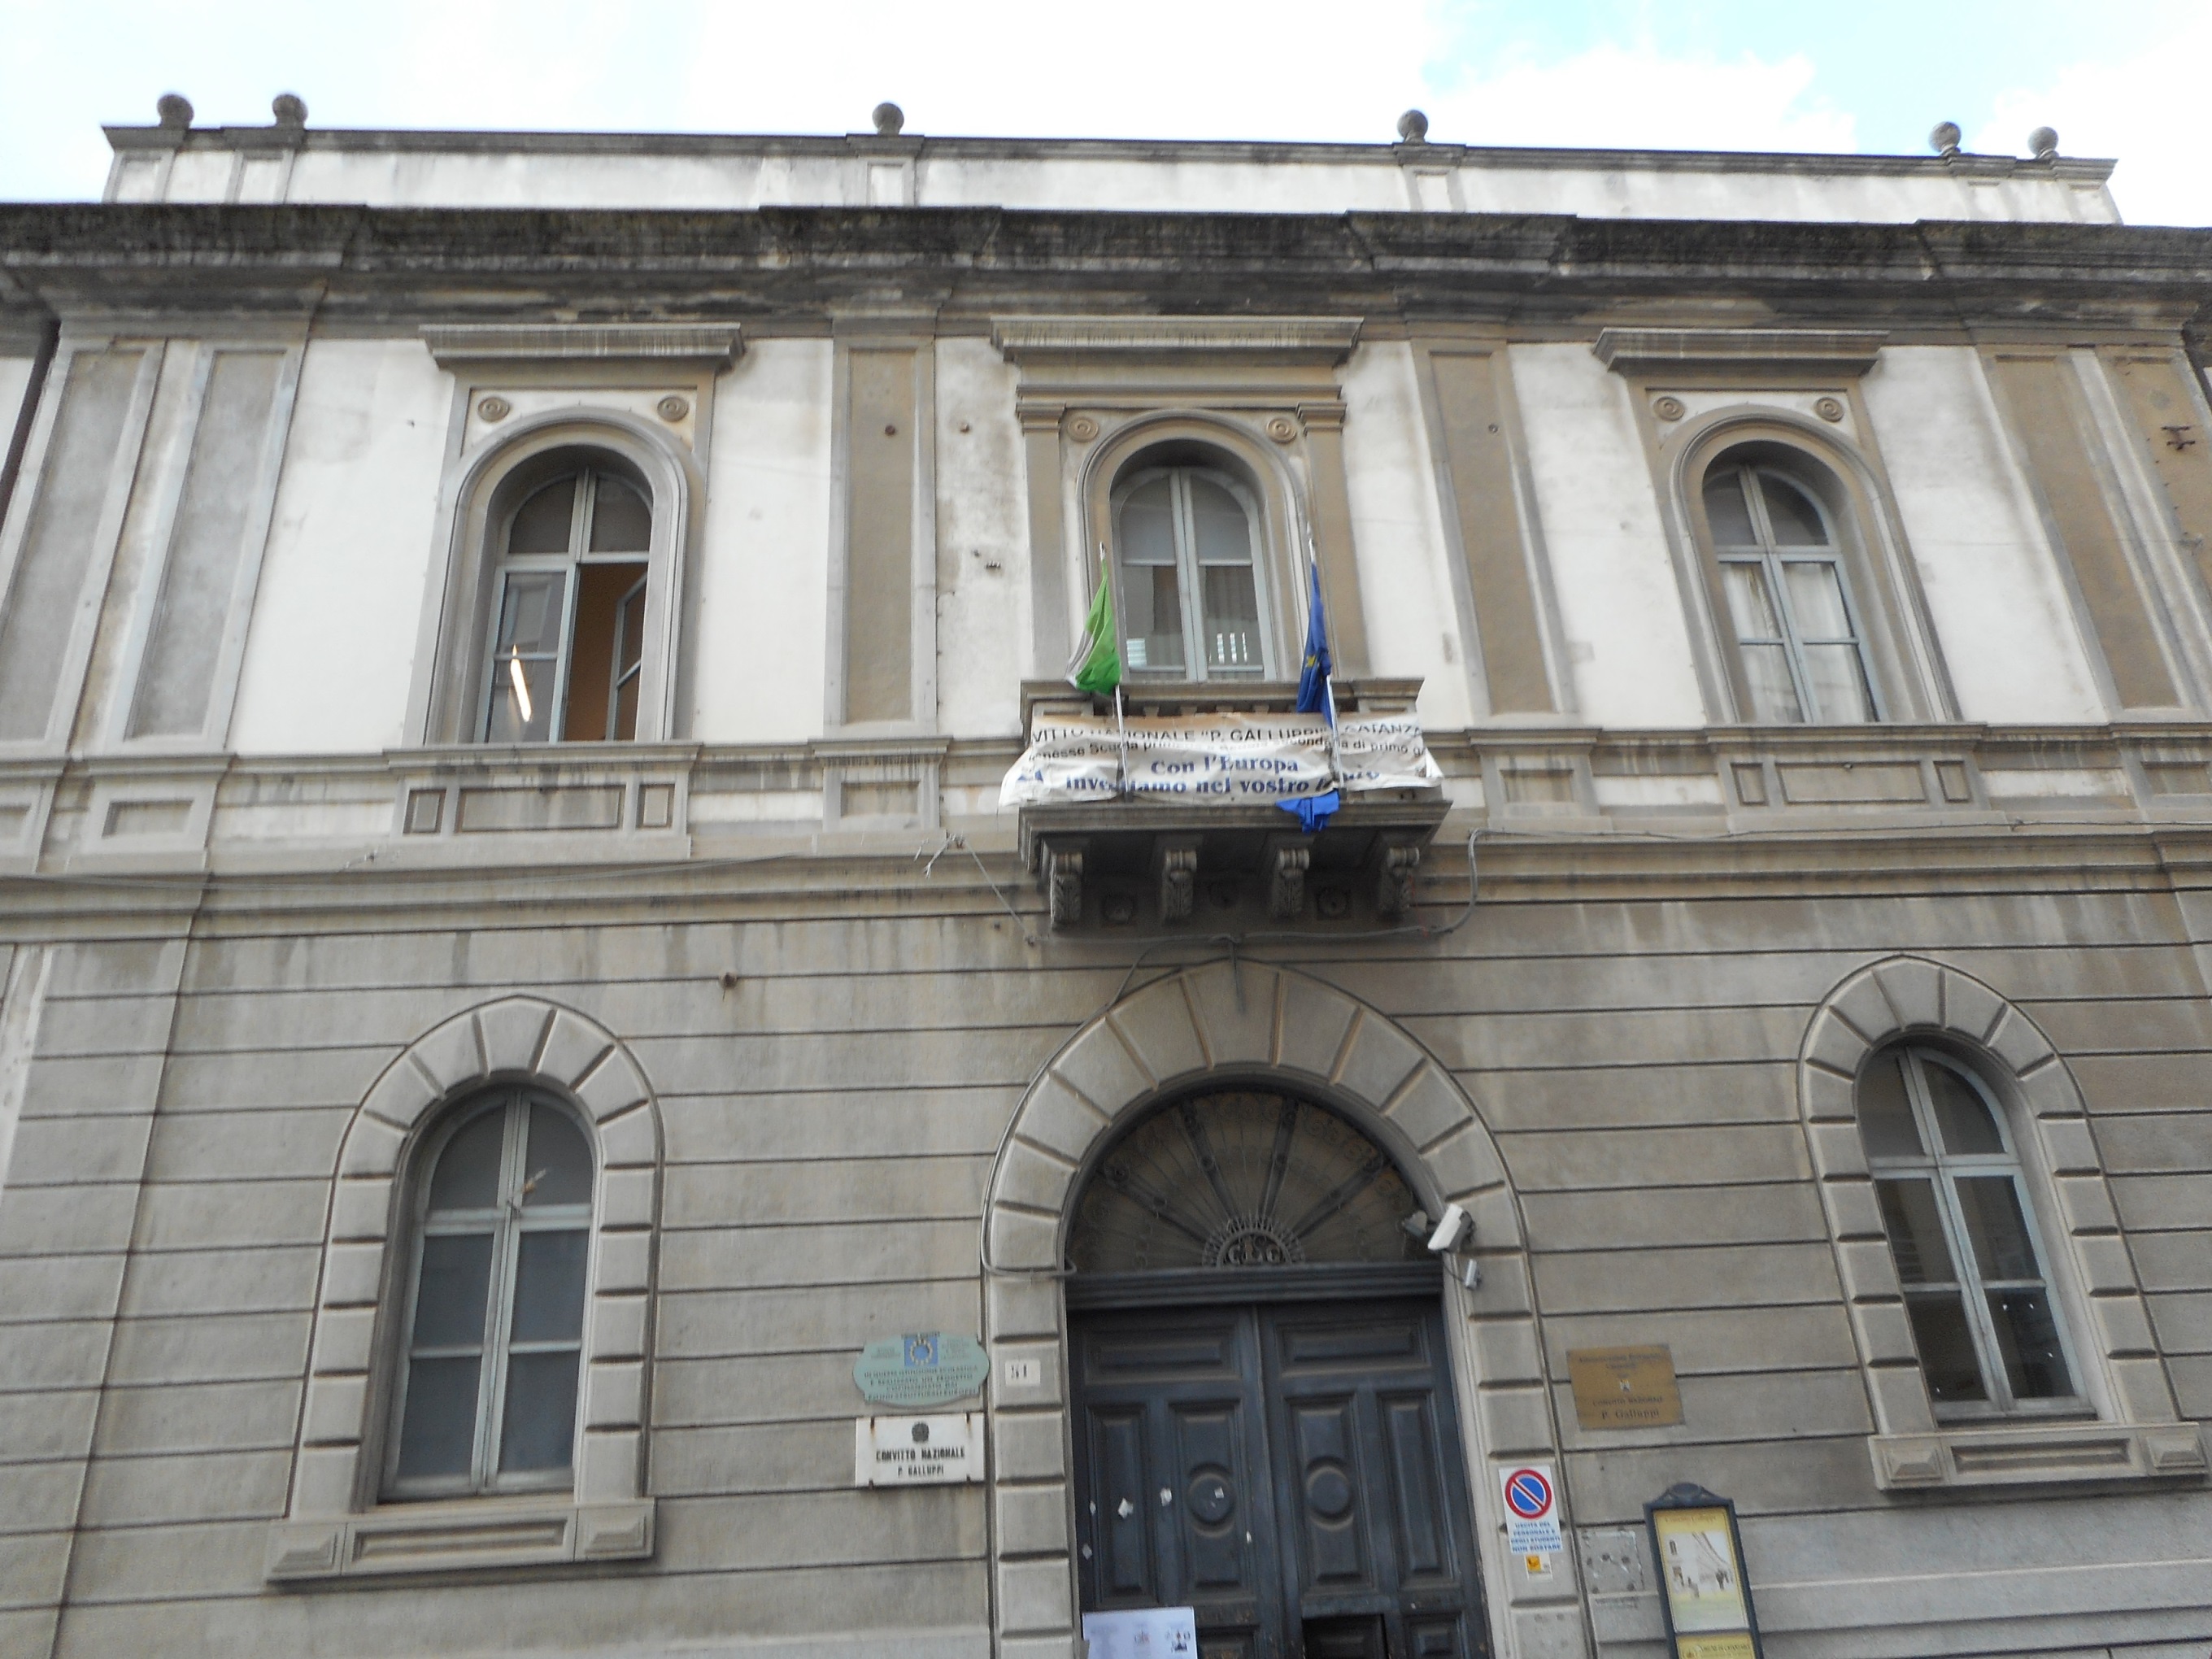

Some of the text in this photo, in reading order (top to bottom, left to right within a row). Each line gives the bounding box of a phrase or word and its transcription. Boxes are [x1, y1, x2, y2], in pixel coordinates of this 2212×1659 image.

[1091, 727, 1195, 742] AIONALE
[1353, 739, 1366, 750] di
[1370, 741, 1409, 755] primo
[1151, 754, 1299, 775] Con l'Europa
[1066, 775, 1187, 794] inveiamo
[1196, 777, 1230, 794] nel
[1240, 777, 1310, 795] vostro
[876, 1446, 965, 1462] CONVITTO NAZIONALE
[908, 1464, 944, 1477] GALLUPPI
[1530, 1544, 1561, 1552] SOSTARE
